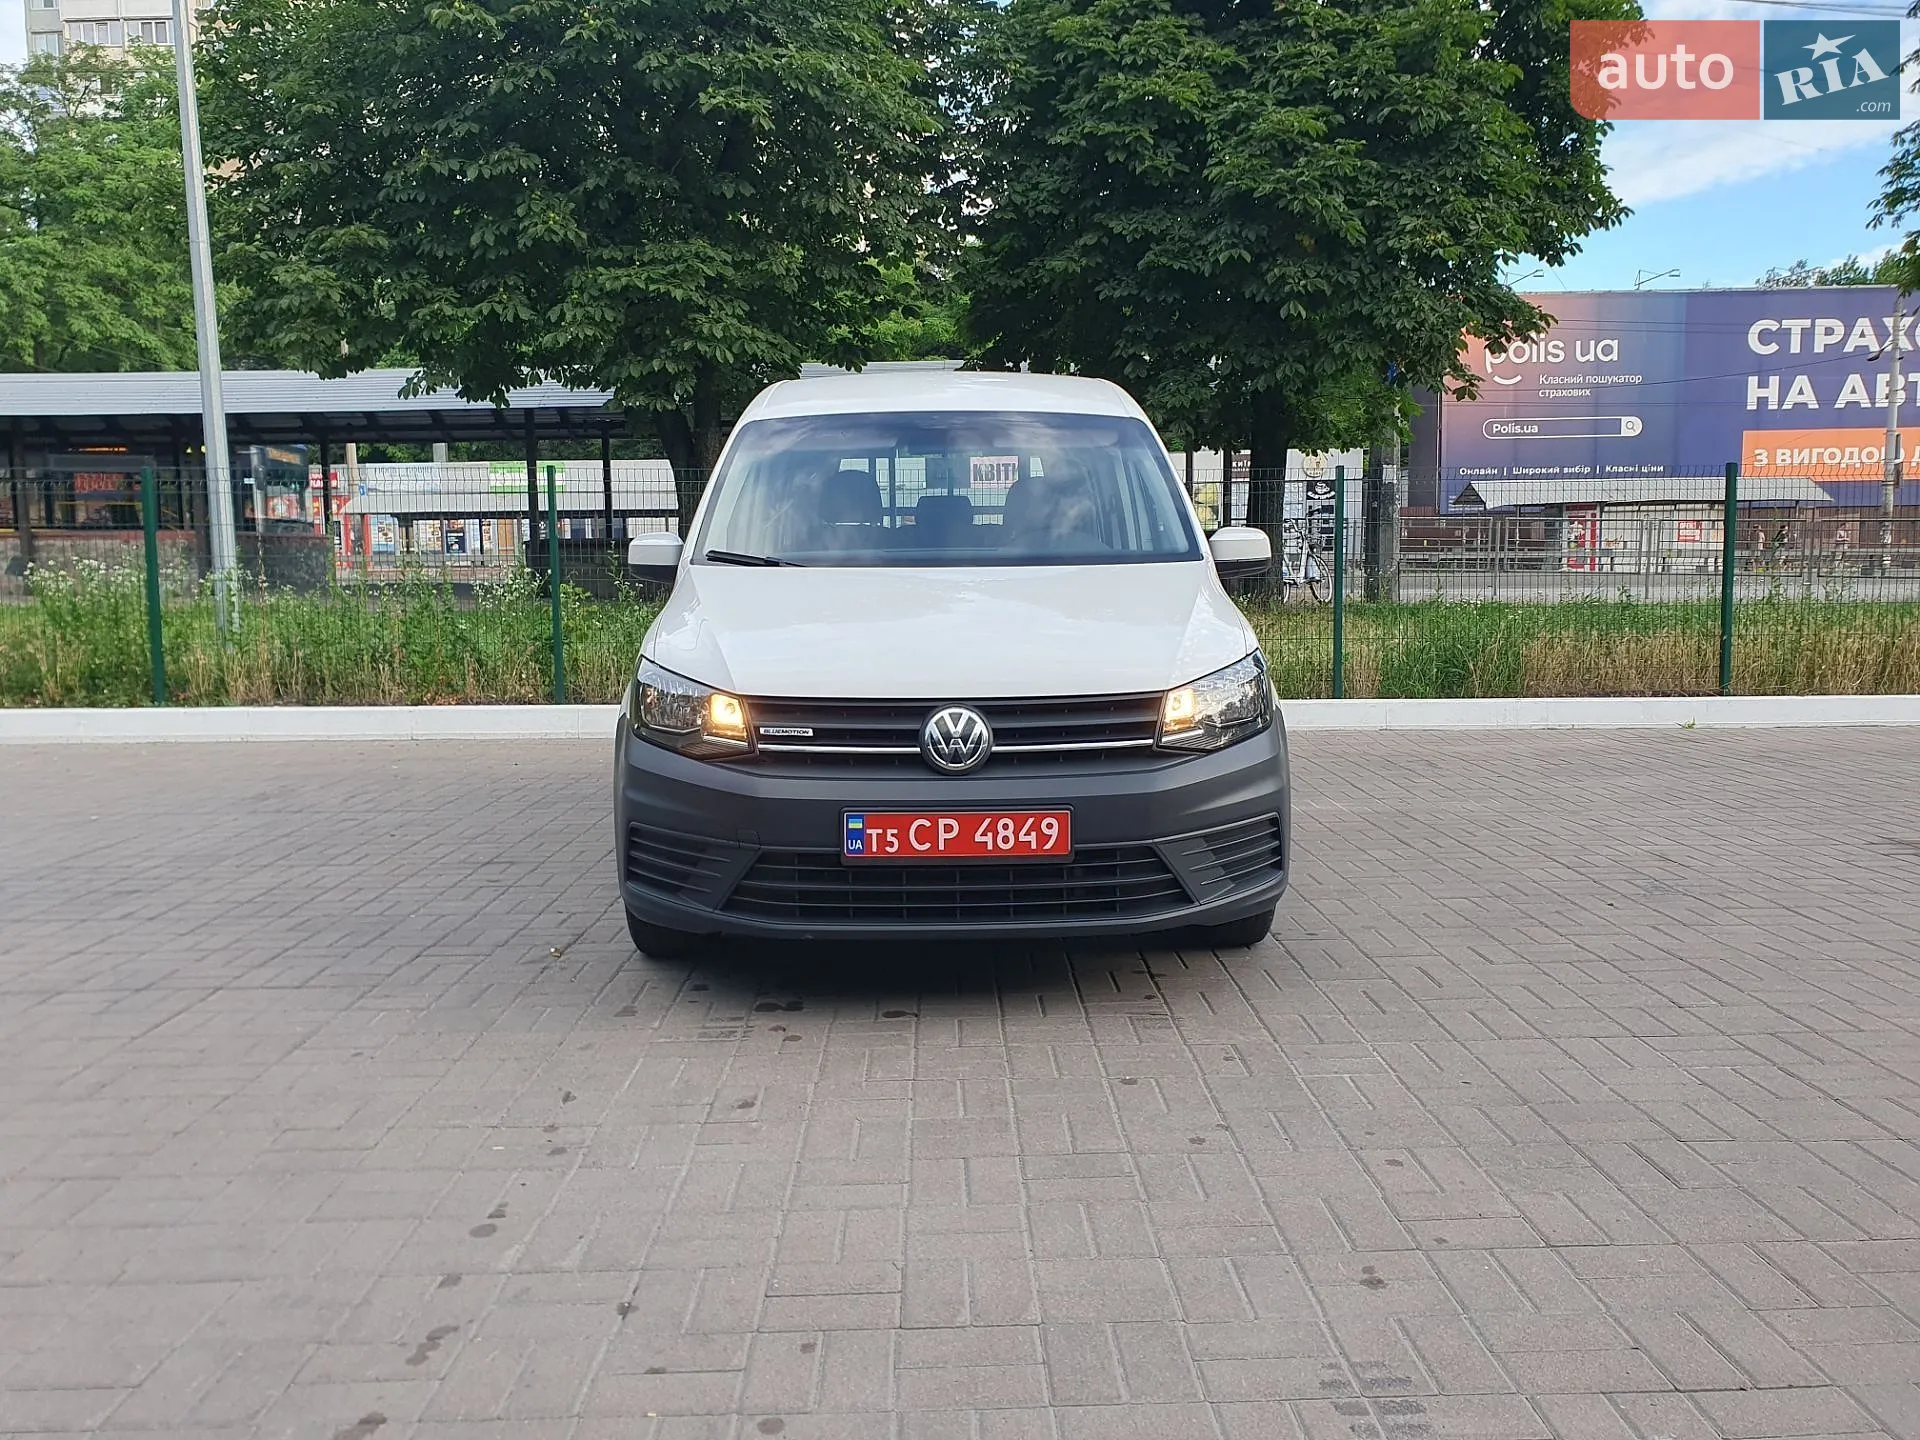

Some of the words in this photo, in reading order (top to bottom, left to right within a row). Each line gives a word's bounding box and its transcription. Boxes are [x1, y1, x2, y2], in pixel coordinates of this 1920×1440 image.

[1486, 333, 1565, 373] polis
[1575, 338, 1619, 363] ua
[1747, 316, 1920, 355] СТРАХ
[1539, 373, 1583, 385] Класний
[1586, 374, 1642, 385] пошукатор
[1539, 387, 1591, 399] страхових
[1746, 374, 1819, 410] НА
[1492, 422, 1539, 434] Polis.ua
[1459, 466, 1498, 476] Онлайн
[1512, 466, 1560, 476] Широкий
[1563, 464, 1591, 475] вибір
[1605, 463, 1639, 474] Класні
[1641, 463, 1665, 474] ціни
[924, 706, 988, 768] VW
[848, 839, 863, 850] UA
[866, 828, 899, 853] T5
[909, 817, 960, 851] CP
[974, 816, 1059, 851] 4849
